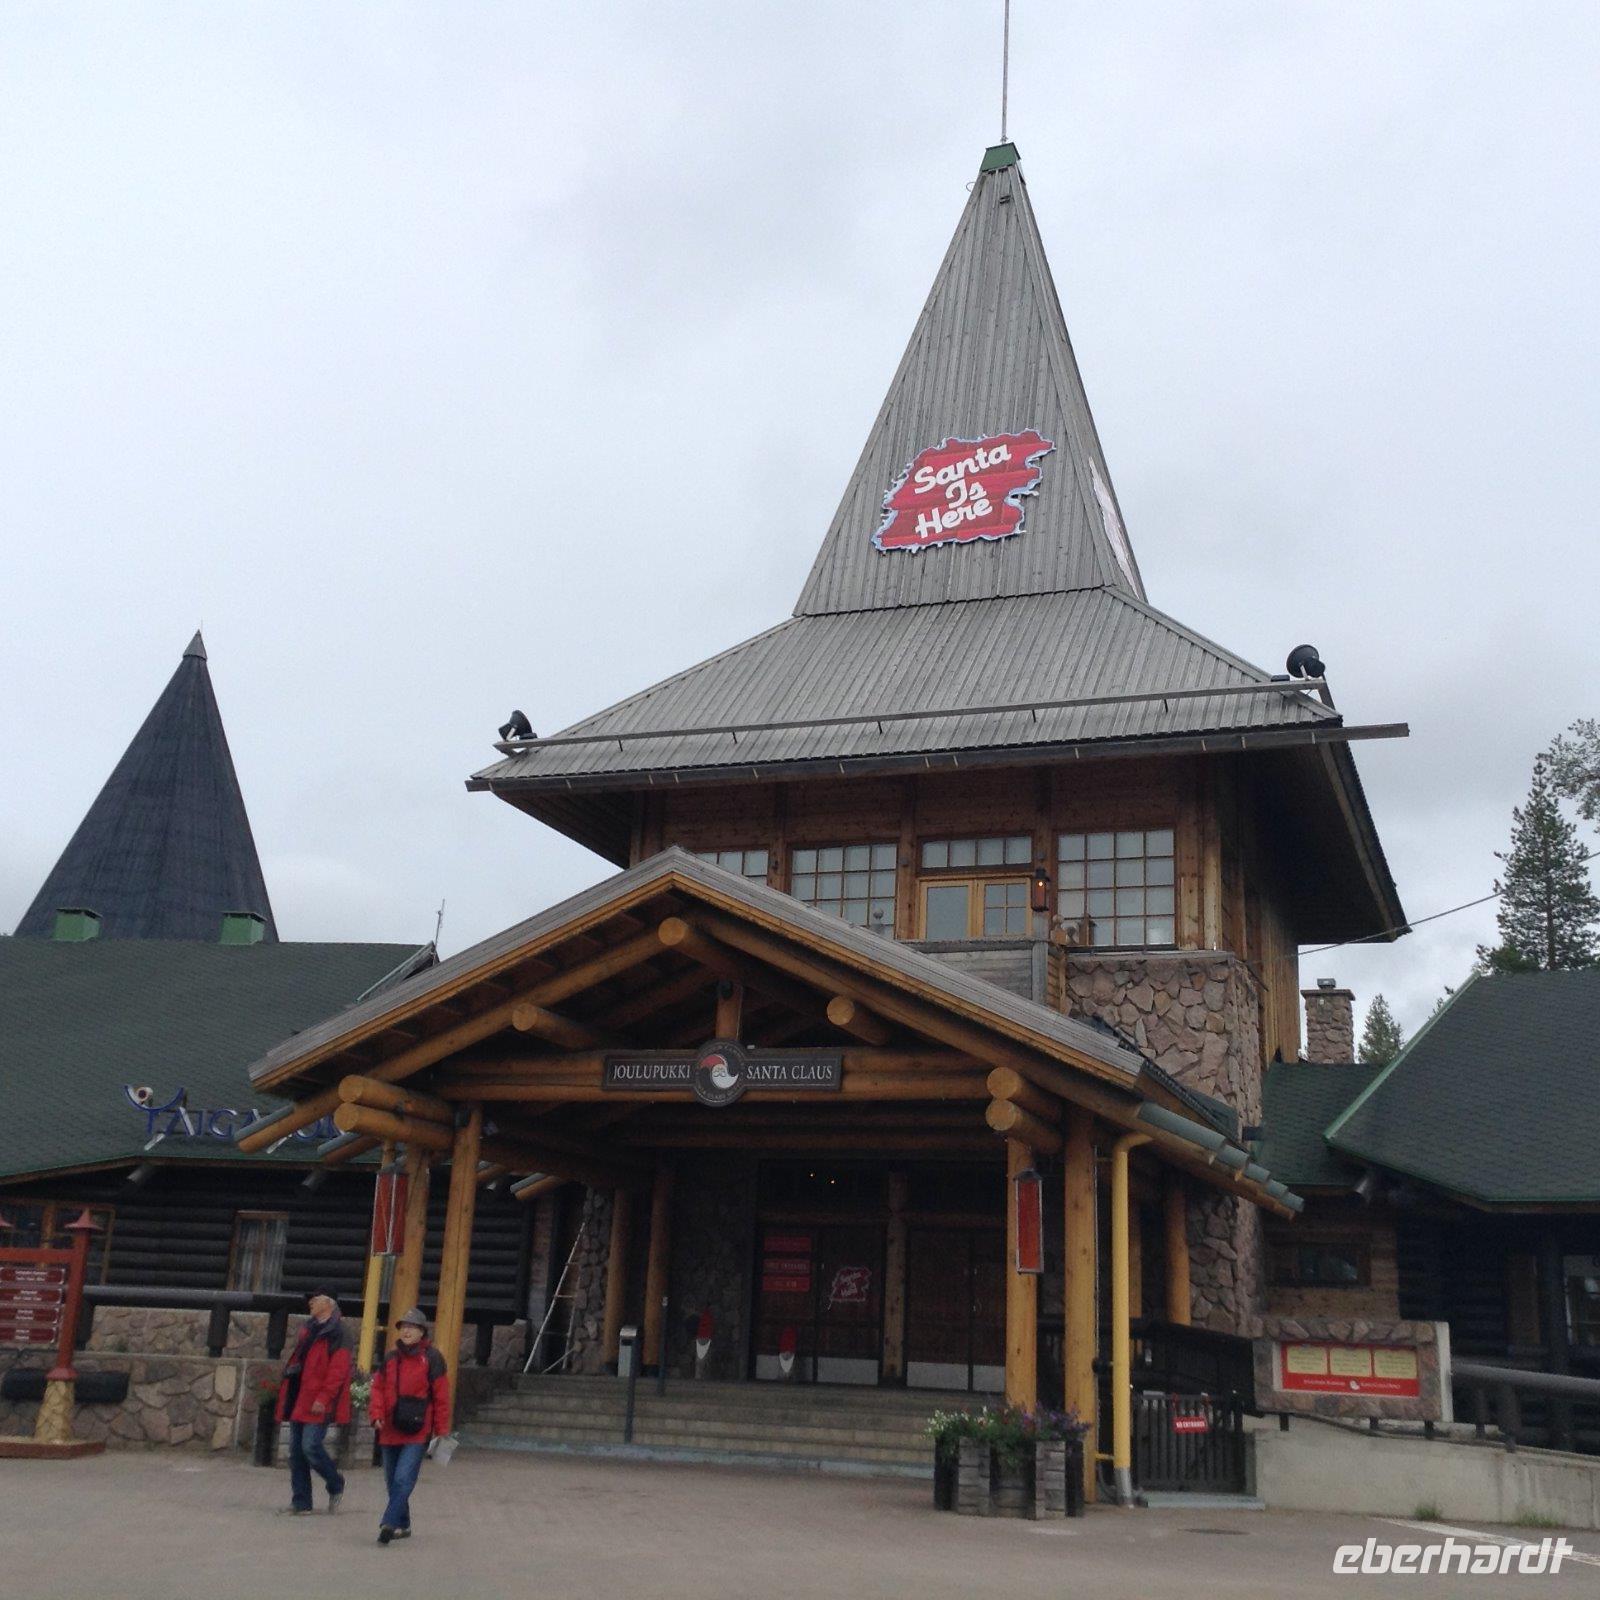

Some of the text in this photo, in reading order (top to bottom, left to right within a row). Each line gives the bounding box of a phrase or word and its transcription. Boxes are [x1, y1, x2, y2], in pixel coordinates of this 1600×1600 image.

[914, 444, 1012, 494] Santa
[945, 478, 987, 509] Is
[915, 498, 993, 539] Here
[613, 1064, 691, 1079] JOULUPUKKI
[746, 1064, 833, 1080] SANTA CLAUS
